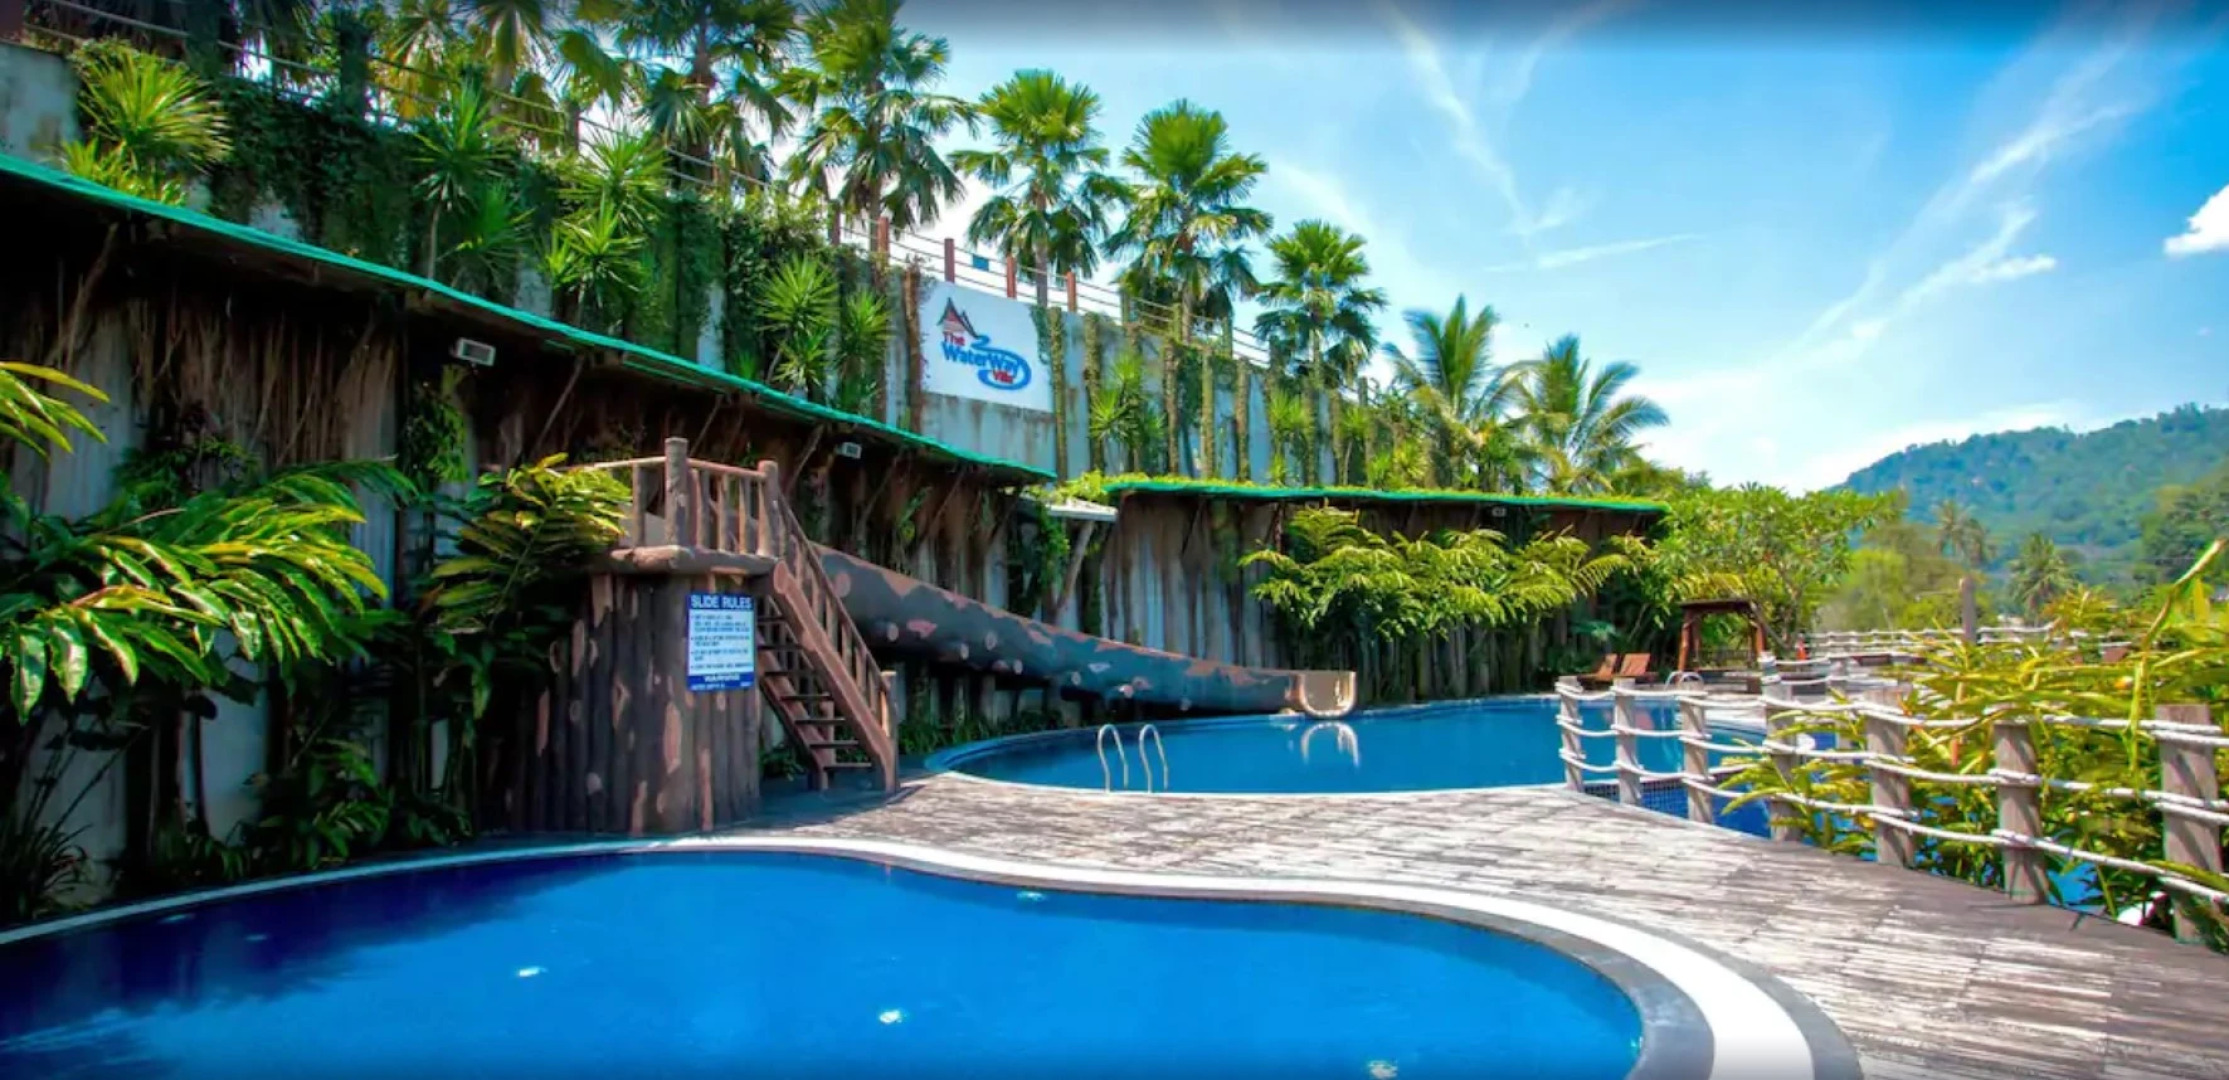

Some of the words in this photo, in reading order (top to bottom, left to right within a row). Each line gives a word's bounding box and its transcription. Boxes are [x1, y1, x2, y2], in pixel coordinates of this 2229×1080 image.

[943, 331, 965, 347] The
[941, 341, 1018, 378] WaterWay
[691, 594, 719, 609] SLIDE
[723, 596, 752, 609] RULES
